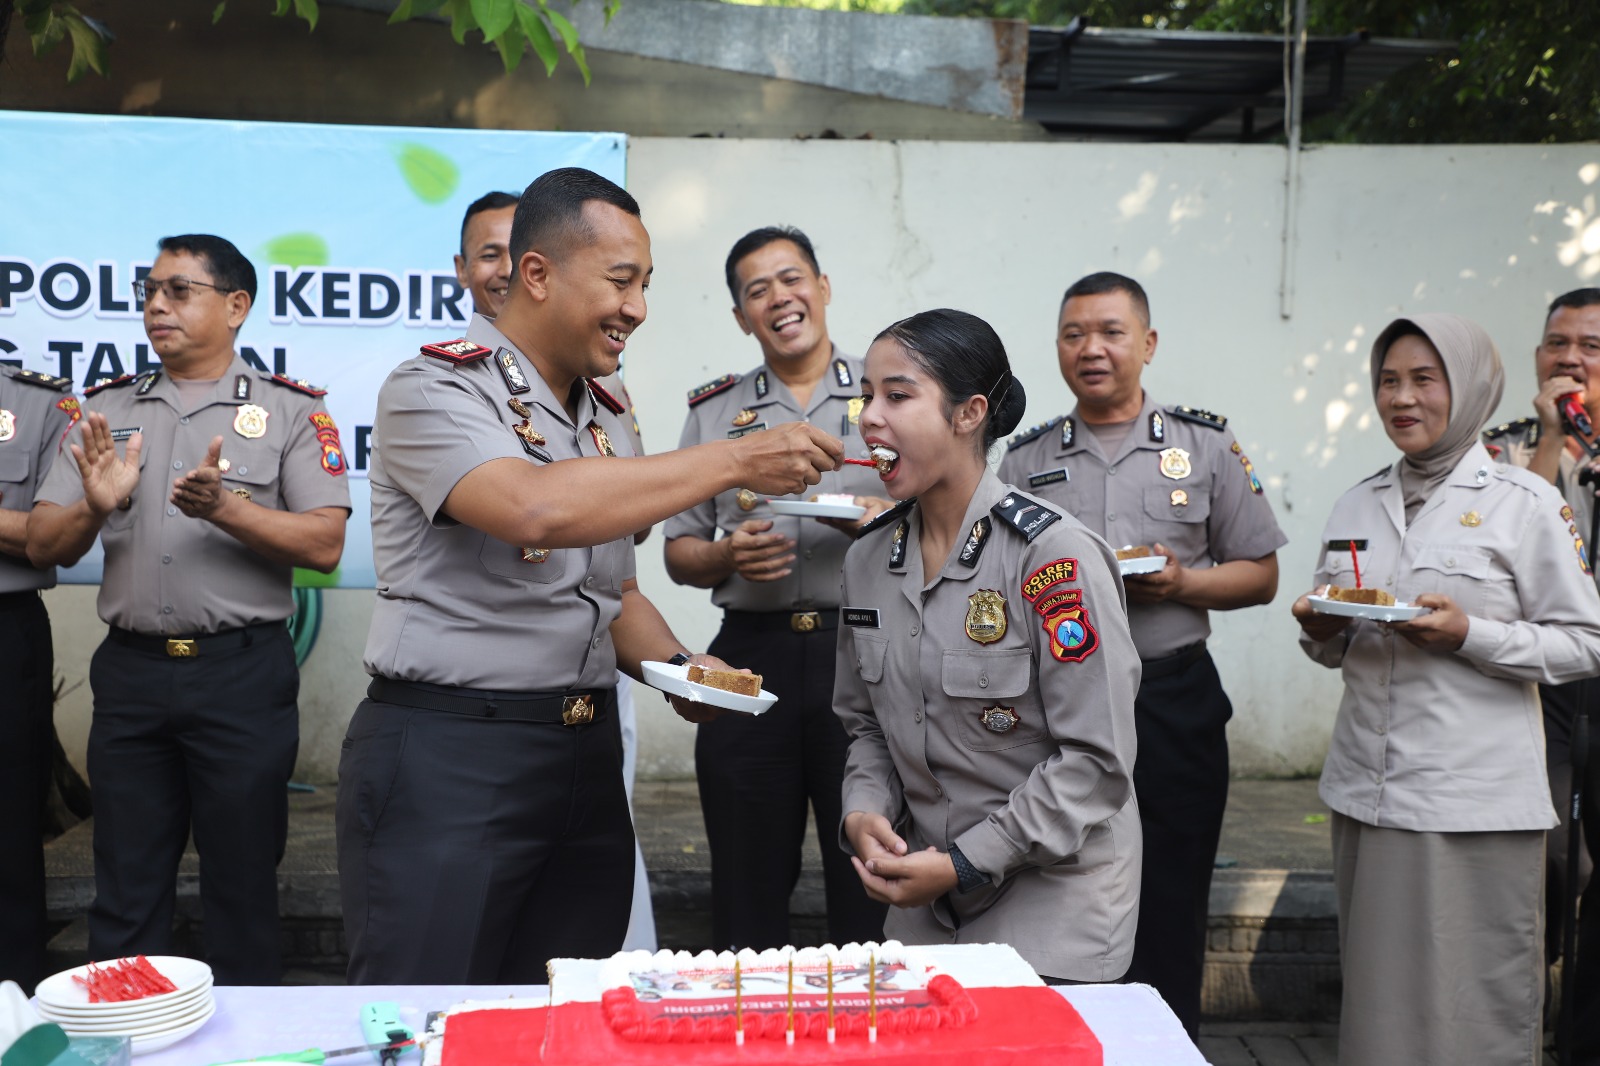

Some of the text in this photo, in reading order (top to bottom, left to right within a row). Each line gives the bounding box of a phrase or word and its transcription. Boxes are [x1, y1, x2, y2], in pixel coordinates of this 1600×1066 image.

[274, 271, 475, 321] KEDIR
[48, 341, 286, 388] TAN
[1024, 562, 1073, 595] POLRES
[1031, 571, 1068, 596] KEDIRI
[1041, 593, 1077, 611] JAWA TIMUR
[664, 1003, 729, 1013] KEDIRI
